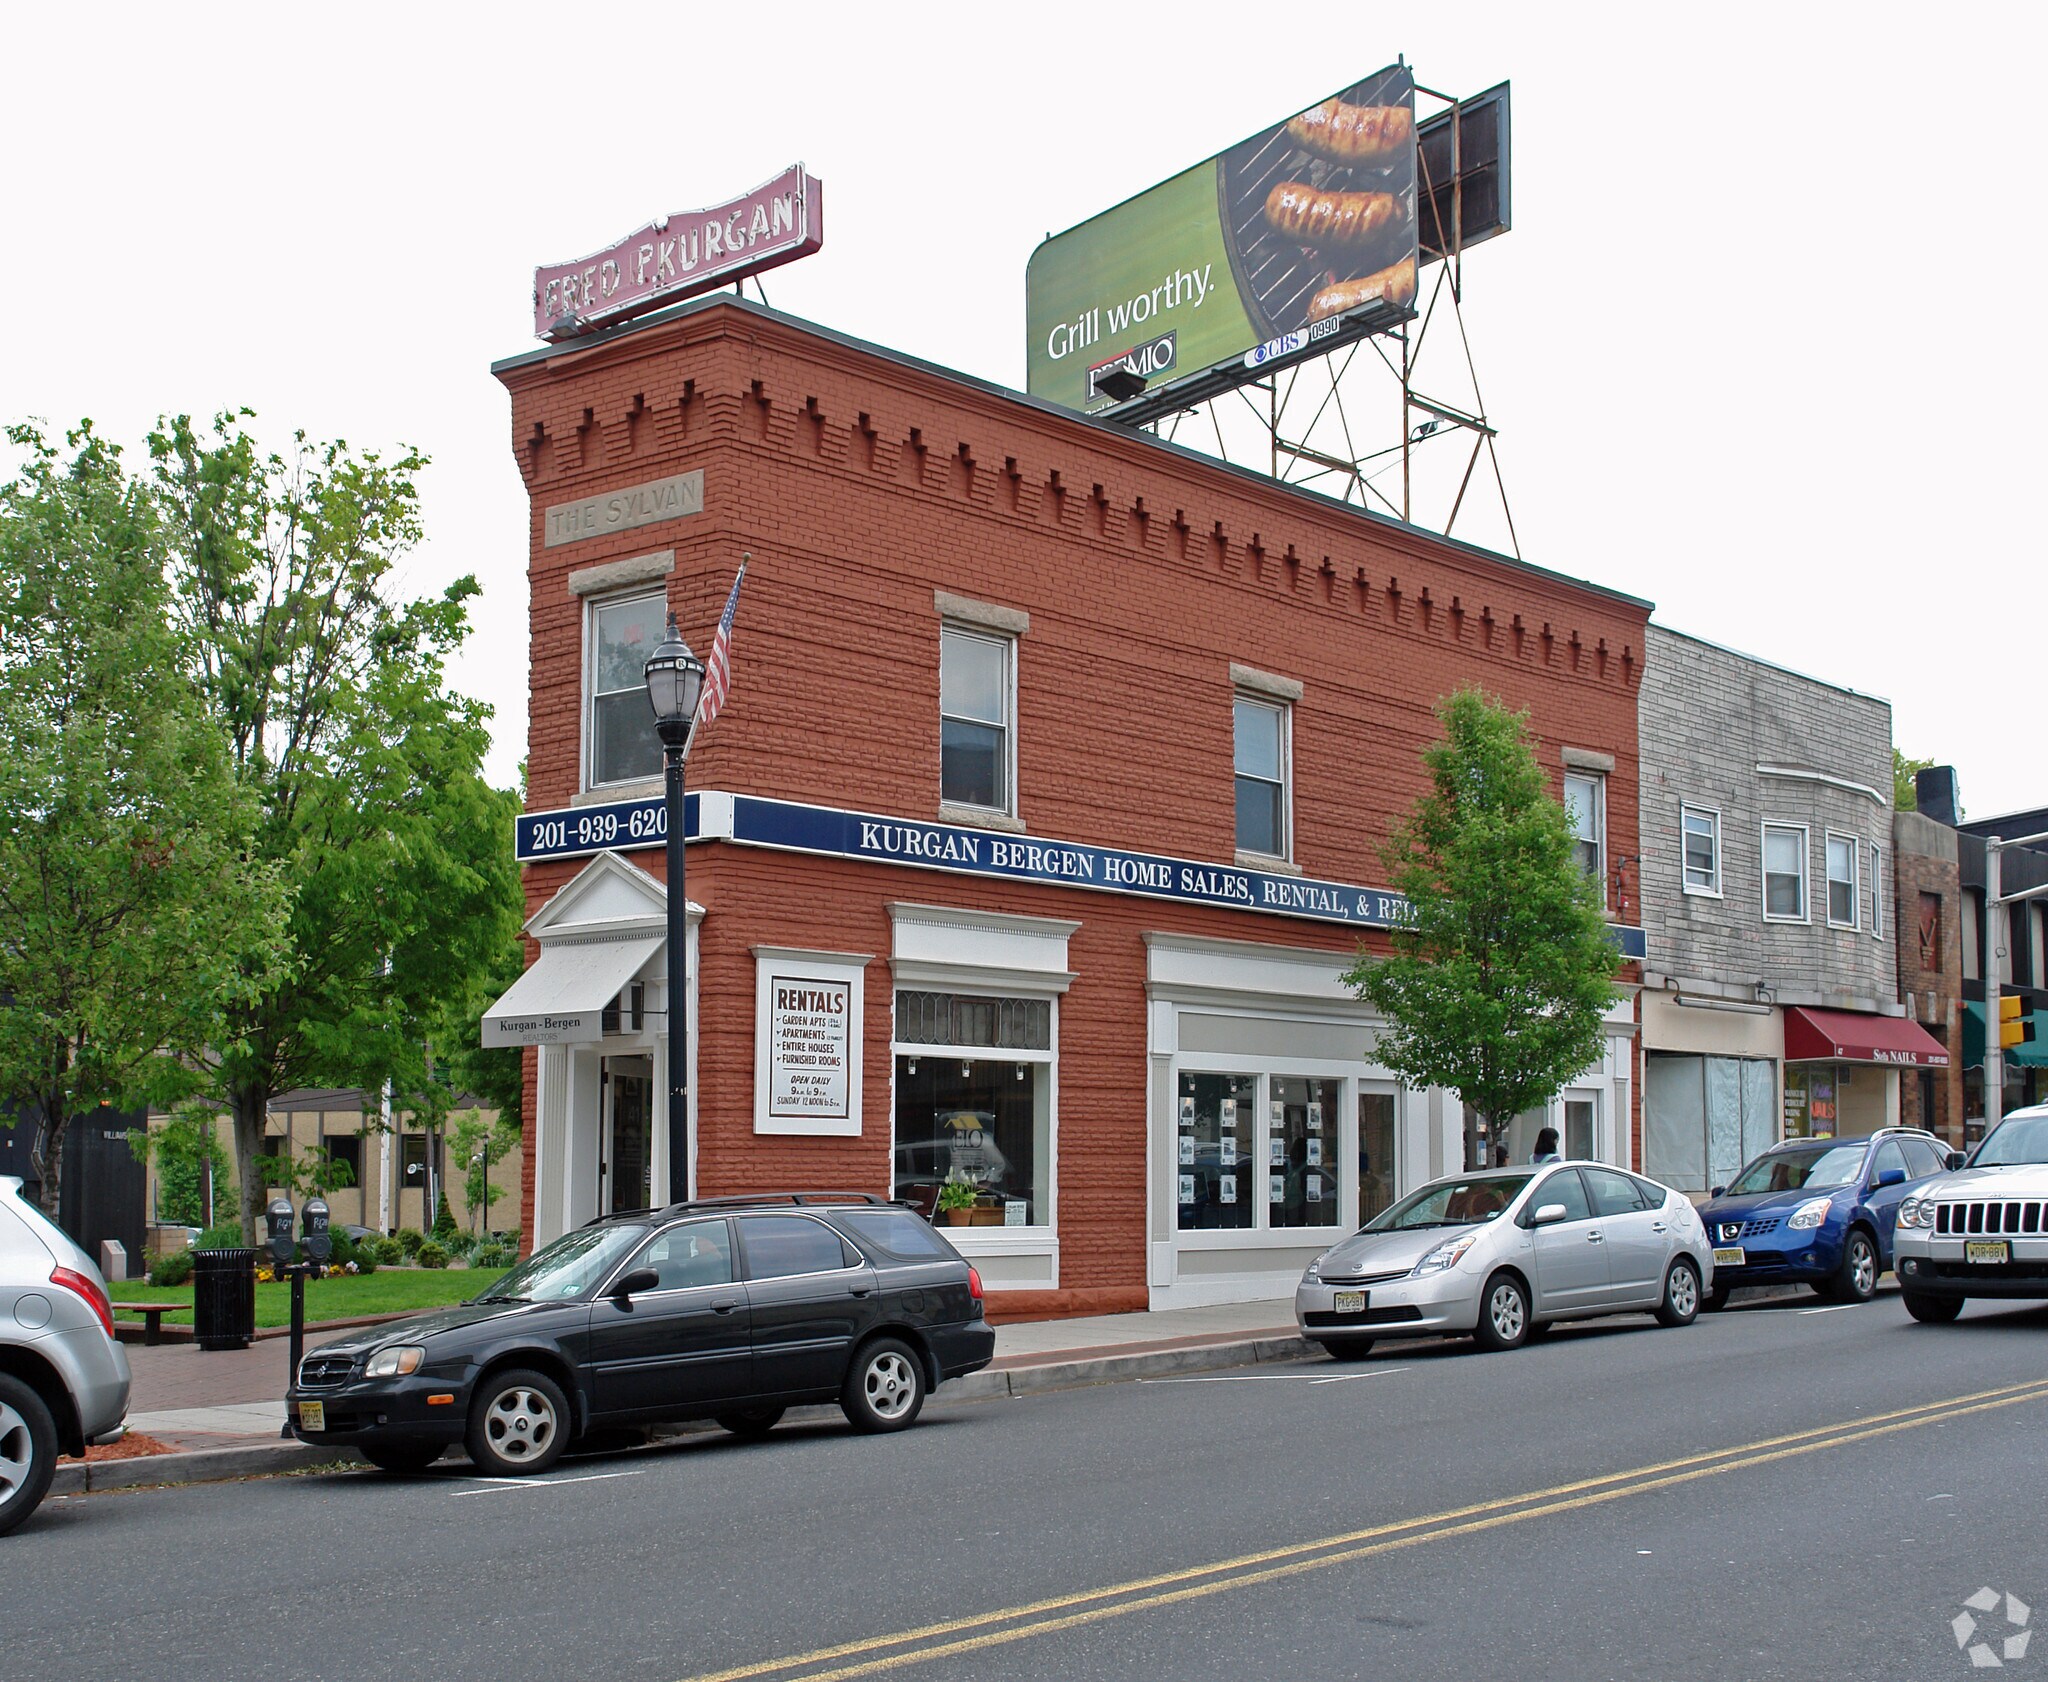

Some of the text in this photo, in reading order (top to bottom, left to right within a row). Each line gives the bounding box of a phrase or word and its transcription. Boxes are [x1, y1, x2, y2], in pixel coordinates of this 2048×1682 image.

[658, 193, 793, 281] KURGAN
[1047, 264, 1215, 359] Grill worthy.
[1312, 316, 1338, 340] 0990
[1269, 332, 1300, 357] CBS
[552, 480, 696, 536] THE SYLVAN
[532, 806, 668, 850] 201-939-620
[860, 822, 980, 863] KURGAN
[991, 841, 1095, 878] BERGEN
[1104, 857, 1172, 889] HOME
[1180, 869, 1255, 906] SALES,
[1263, 880, 1349, 919] RENTAL,
[1357, 895, 1370, 917] &
[778, 988, 844, 1014] RENTALS
[782, 1015, 808, 1026] GARDEN
[810, 1017, 826, 1027] APTS
[782, 1028, 826, 1040] APARTMENTS
[782, 1041, 835, 1053] ENTIRE HOUSES
[1890, 1051, 1917, 1064] NAILS
[782, 1054, 841, 1066] FURNISHED ROOMS
[791, 1075, 831, 1085] OPEN DAILY
[777, 1096, 800, 1105] SUNDAY
[809, 1097, 823, 1106] NOON
